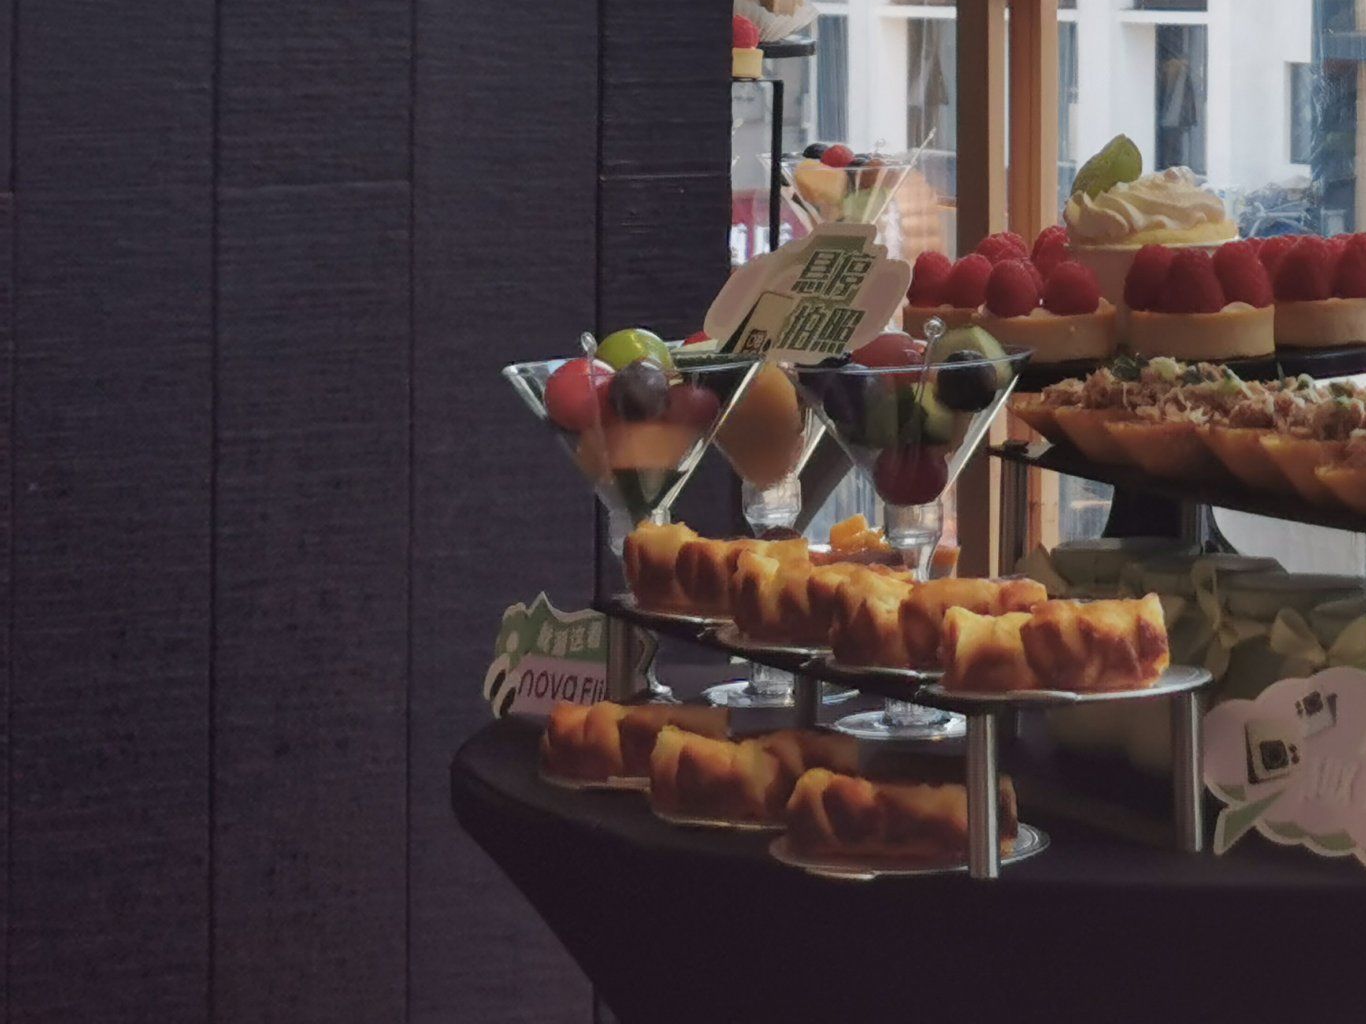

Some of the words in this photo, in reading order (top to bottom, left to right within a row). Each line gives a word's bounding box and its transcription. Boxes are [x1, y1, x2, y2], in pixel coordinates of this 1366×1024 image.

[777, 306, 866, 354] 拍照
[518, 669, 578, 702] nova
[580, 677, 607, 706] Fli
